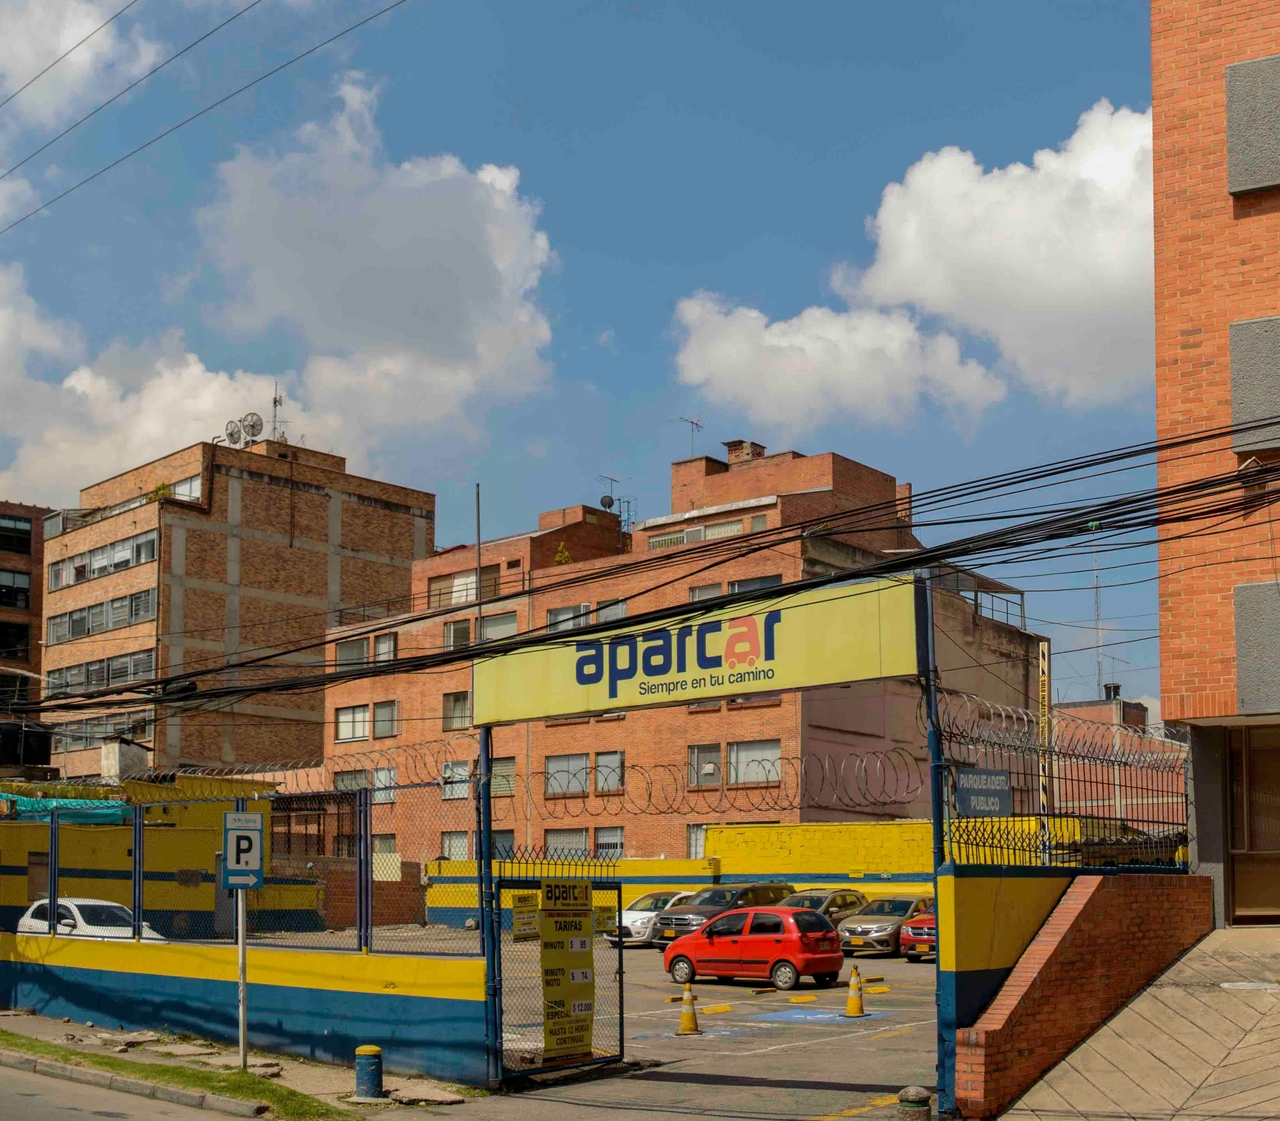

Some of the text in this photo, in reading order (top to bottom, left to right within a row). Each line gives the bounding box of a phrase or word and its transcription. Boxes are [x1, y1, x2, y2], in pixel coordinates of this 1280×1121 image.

[576, 609, 782, 699] aparcar
[638, 667, 775, 696] Siempre en tu camino
[959, 773, 1010, 791] PARQUEADERO
[235, 835, 253, 865] P
[554, 920, 582, 932] TARIFAS
[543, 941, 565, 950] MINUTO
[544, 968, 565, 977] MINUTO
[545, 978, 561, 987] MOTO
[546, 1010, 571, 1020] ESPECIAL
[549, 1026, 567, 1037] HASTA
